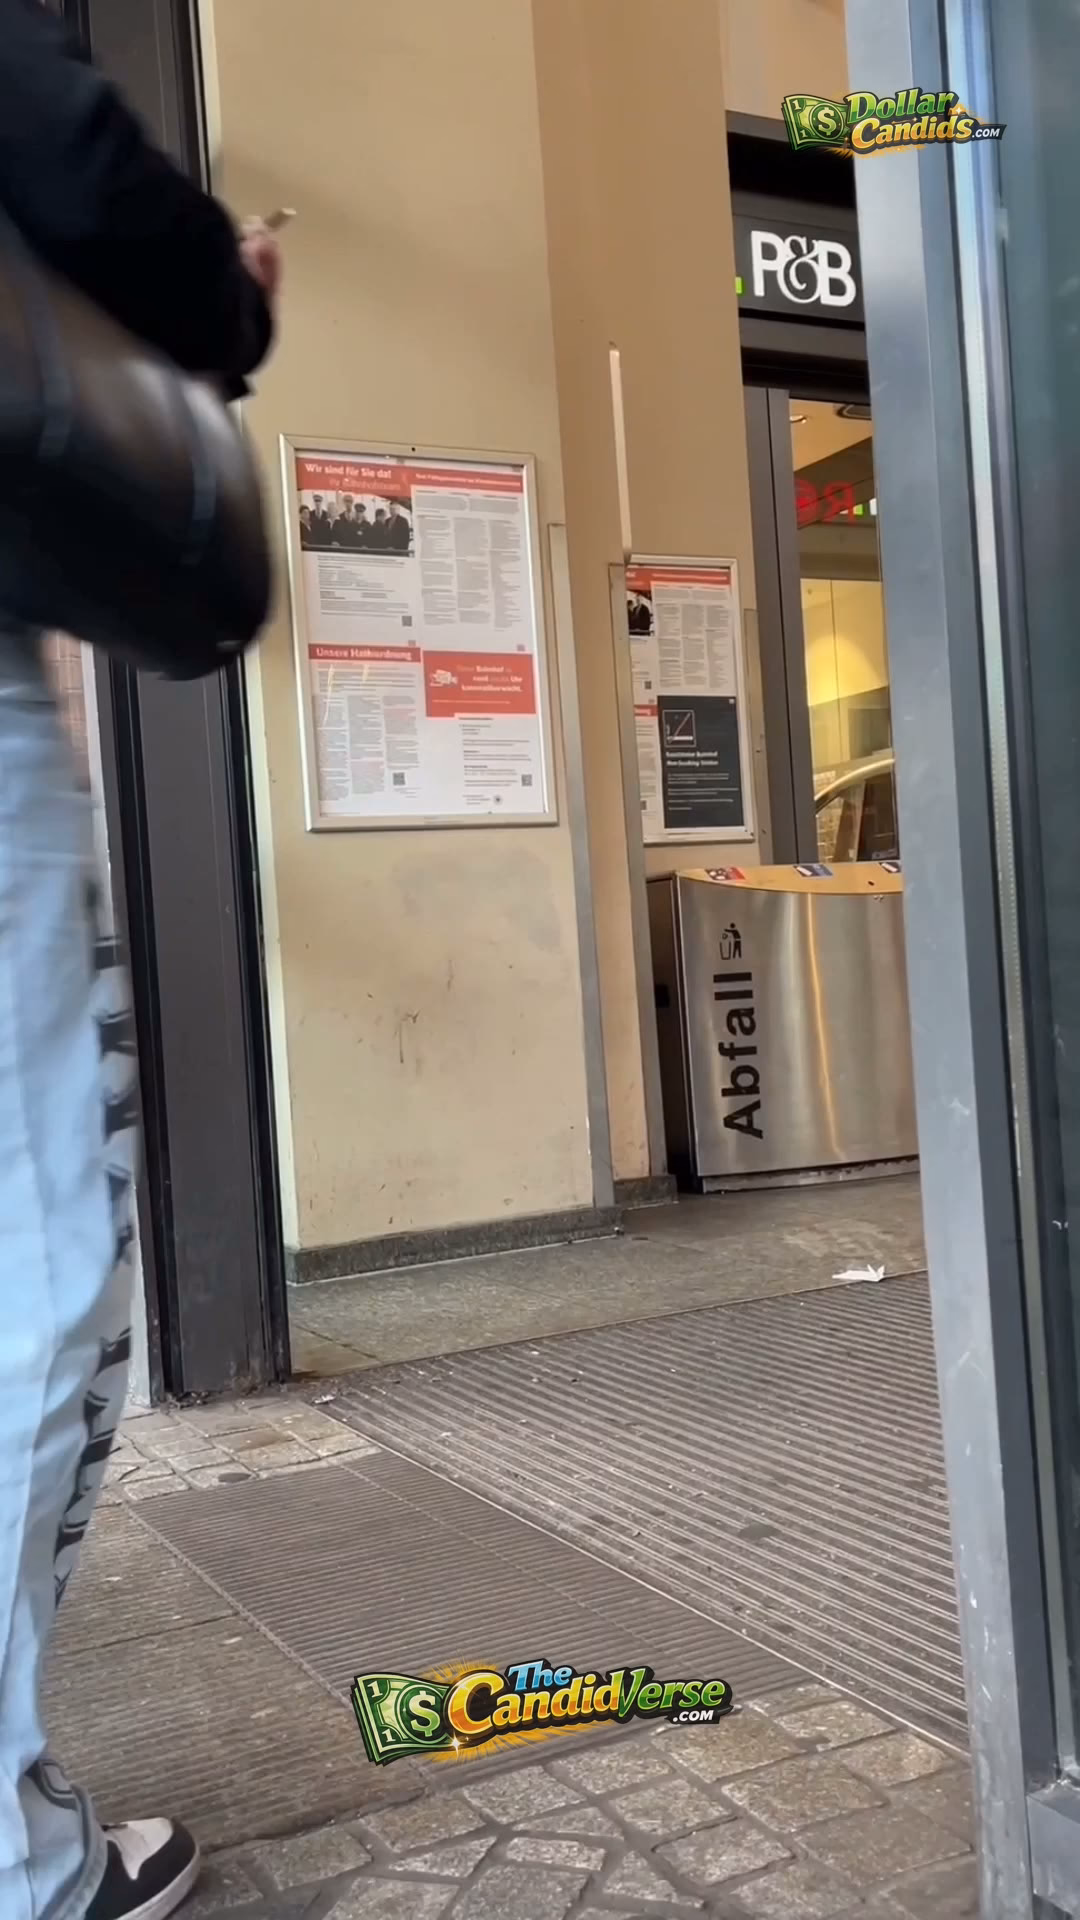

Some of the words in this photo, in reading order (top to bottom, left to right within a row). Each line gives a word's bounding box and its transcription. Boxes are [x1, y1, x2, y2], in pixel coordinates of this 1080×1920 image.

[751, 230, 857, 307] P&B
[304, 463, 323, 473] Wir
[713, 971, 764, 1139] Abfall
